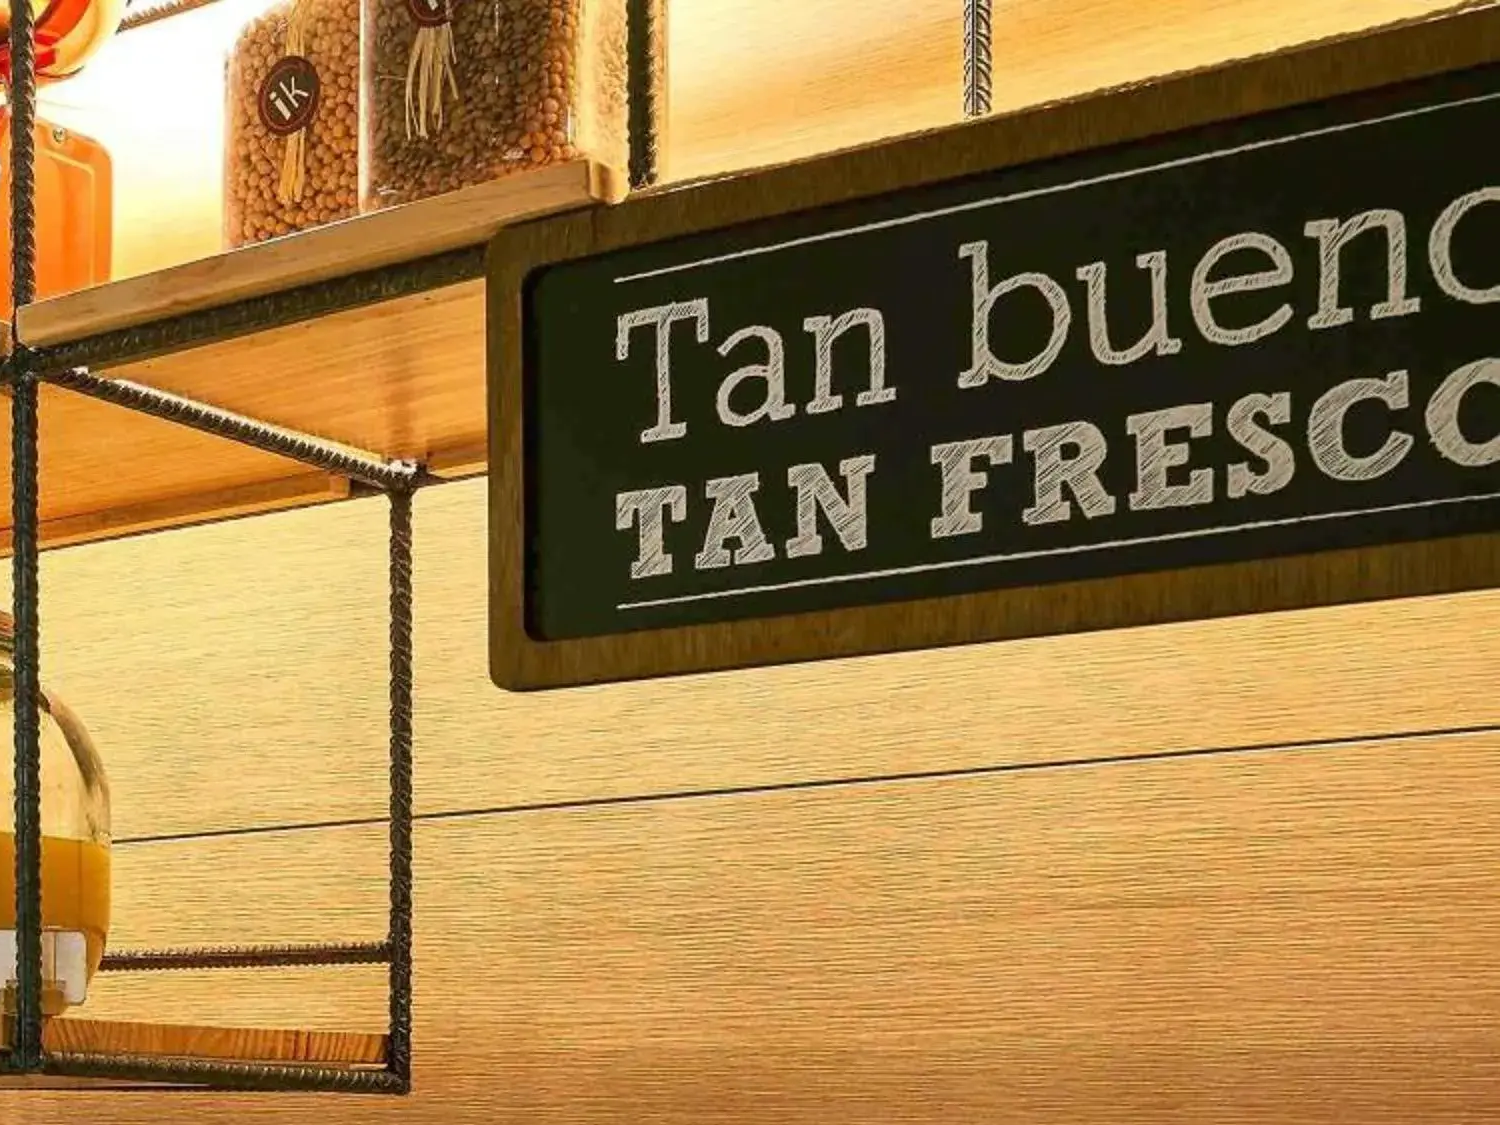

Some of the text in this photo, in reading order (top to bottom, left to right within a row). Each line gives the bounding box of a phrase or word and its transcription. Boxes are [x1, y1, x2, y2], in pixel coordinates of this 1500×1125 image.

[269, 76, 309, 120] ik
[615, 298, 898, 444] Tan
[615, 455, 876, 580] TAN
